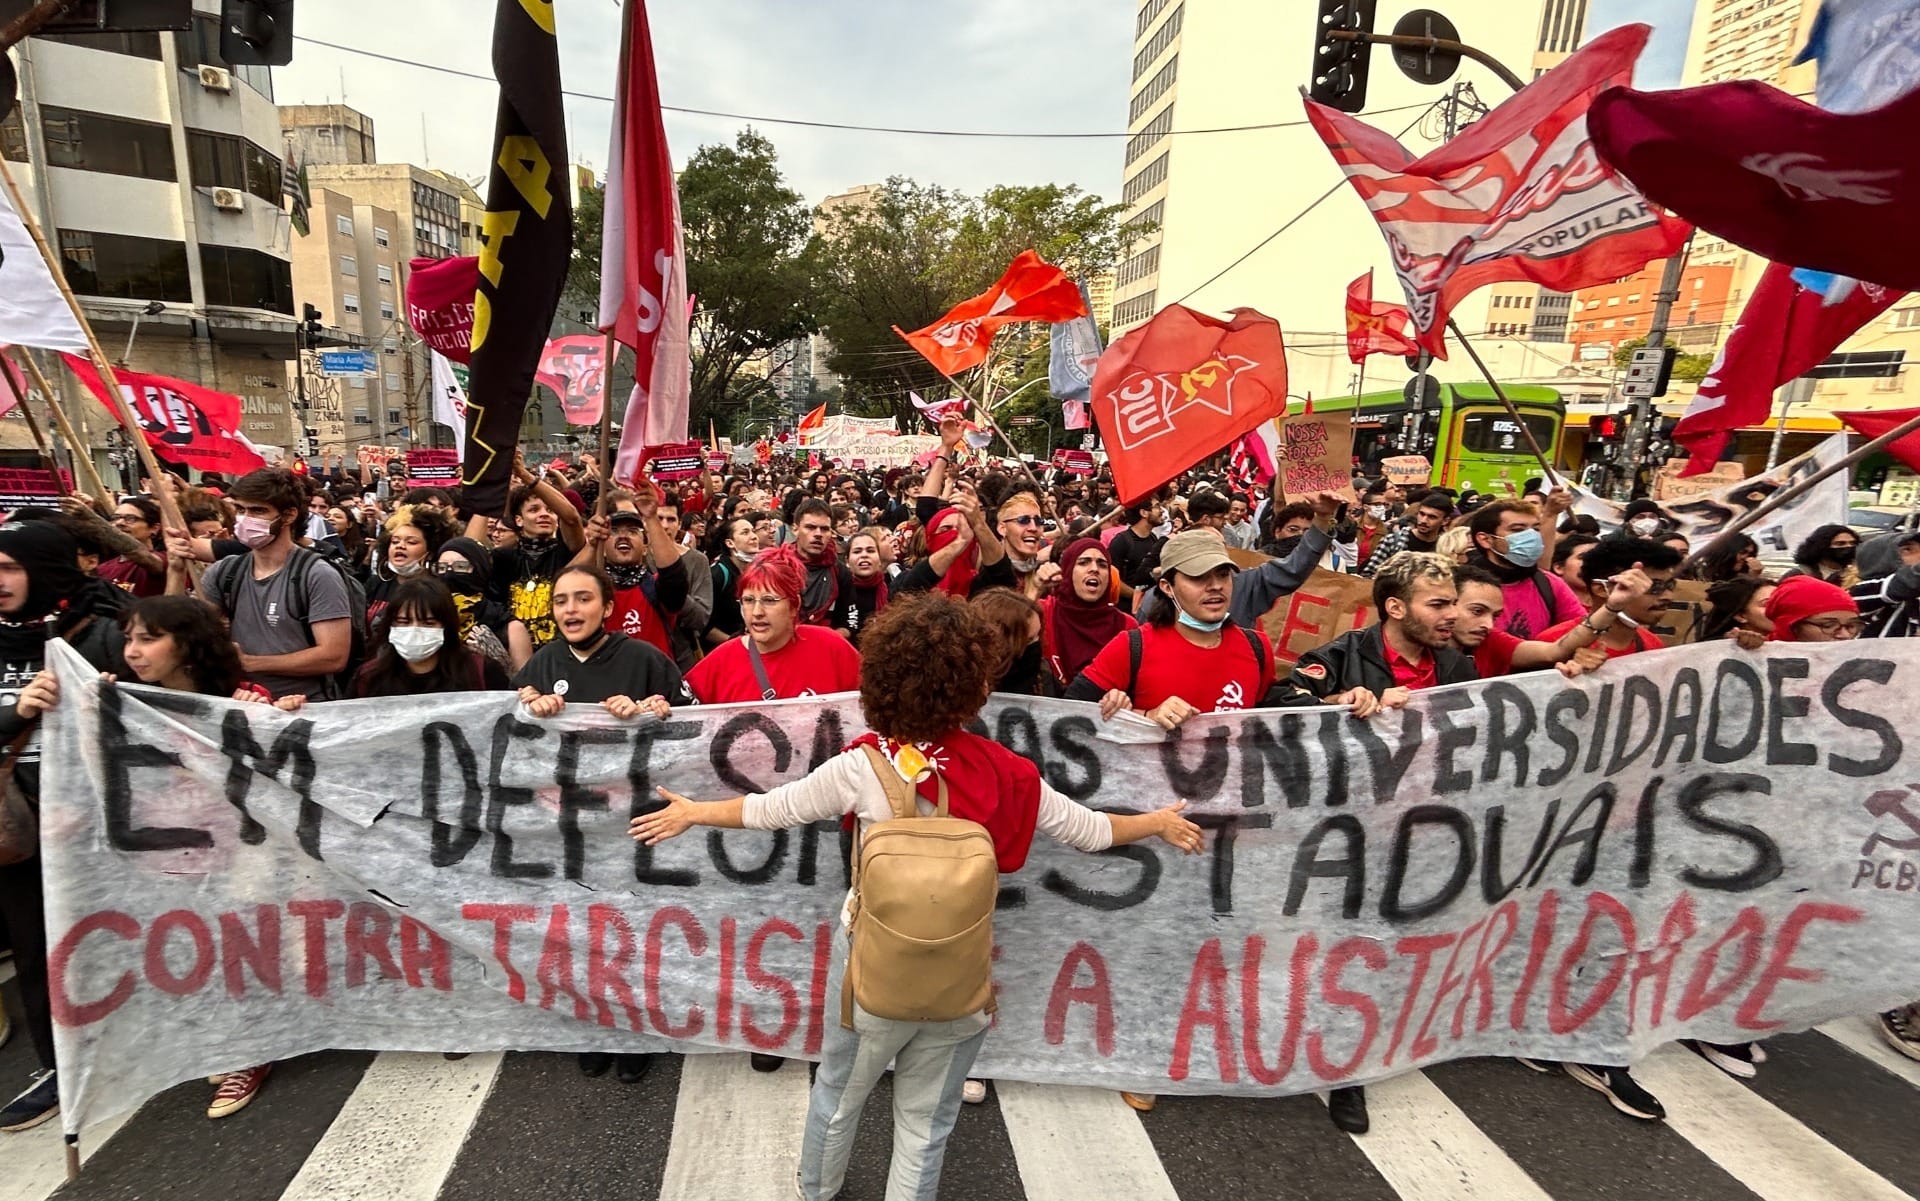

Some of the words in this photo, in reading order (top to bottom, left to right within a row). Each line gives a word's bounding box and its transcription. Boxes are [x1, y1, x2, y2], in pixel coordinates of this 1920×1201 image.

[1285, 421, 1328, 446] NOSSA
[1286, 464, 1328, 482] NOSSA
[98, 680, 325, 862] EM
[420, 708, 858, 888] DEFESA
[1160, 657, 1904, 807] UNIVERSIDADES
[1000, 772, 1785, 922] STADUAIS
[49, 899, 454, 1028] CONTRA
[1043, 940, 1115, 1057] A
[1166, 888, 1867, 1087] AUSTERIDADE
